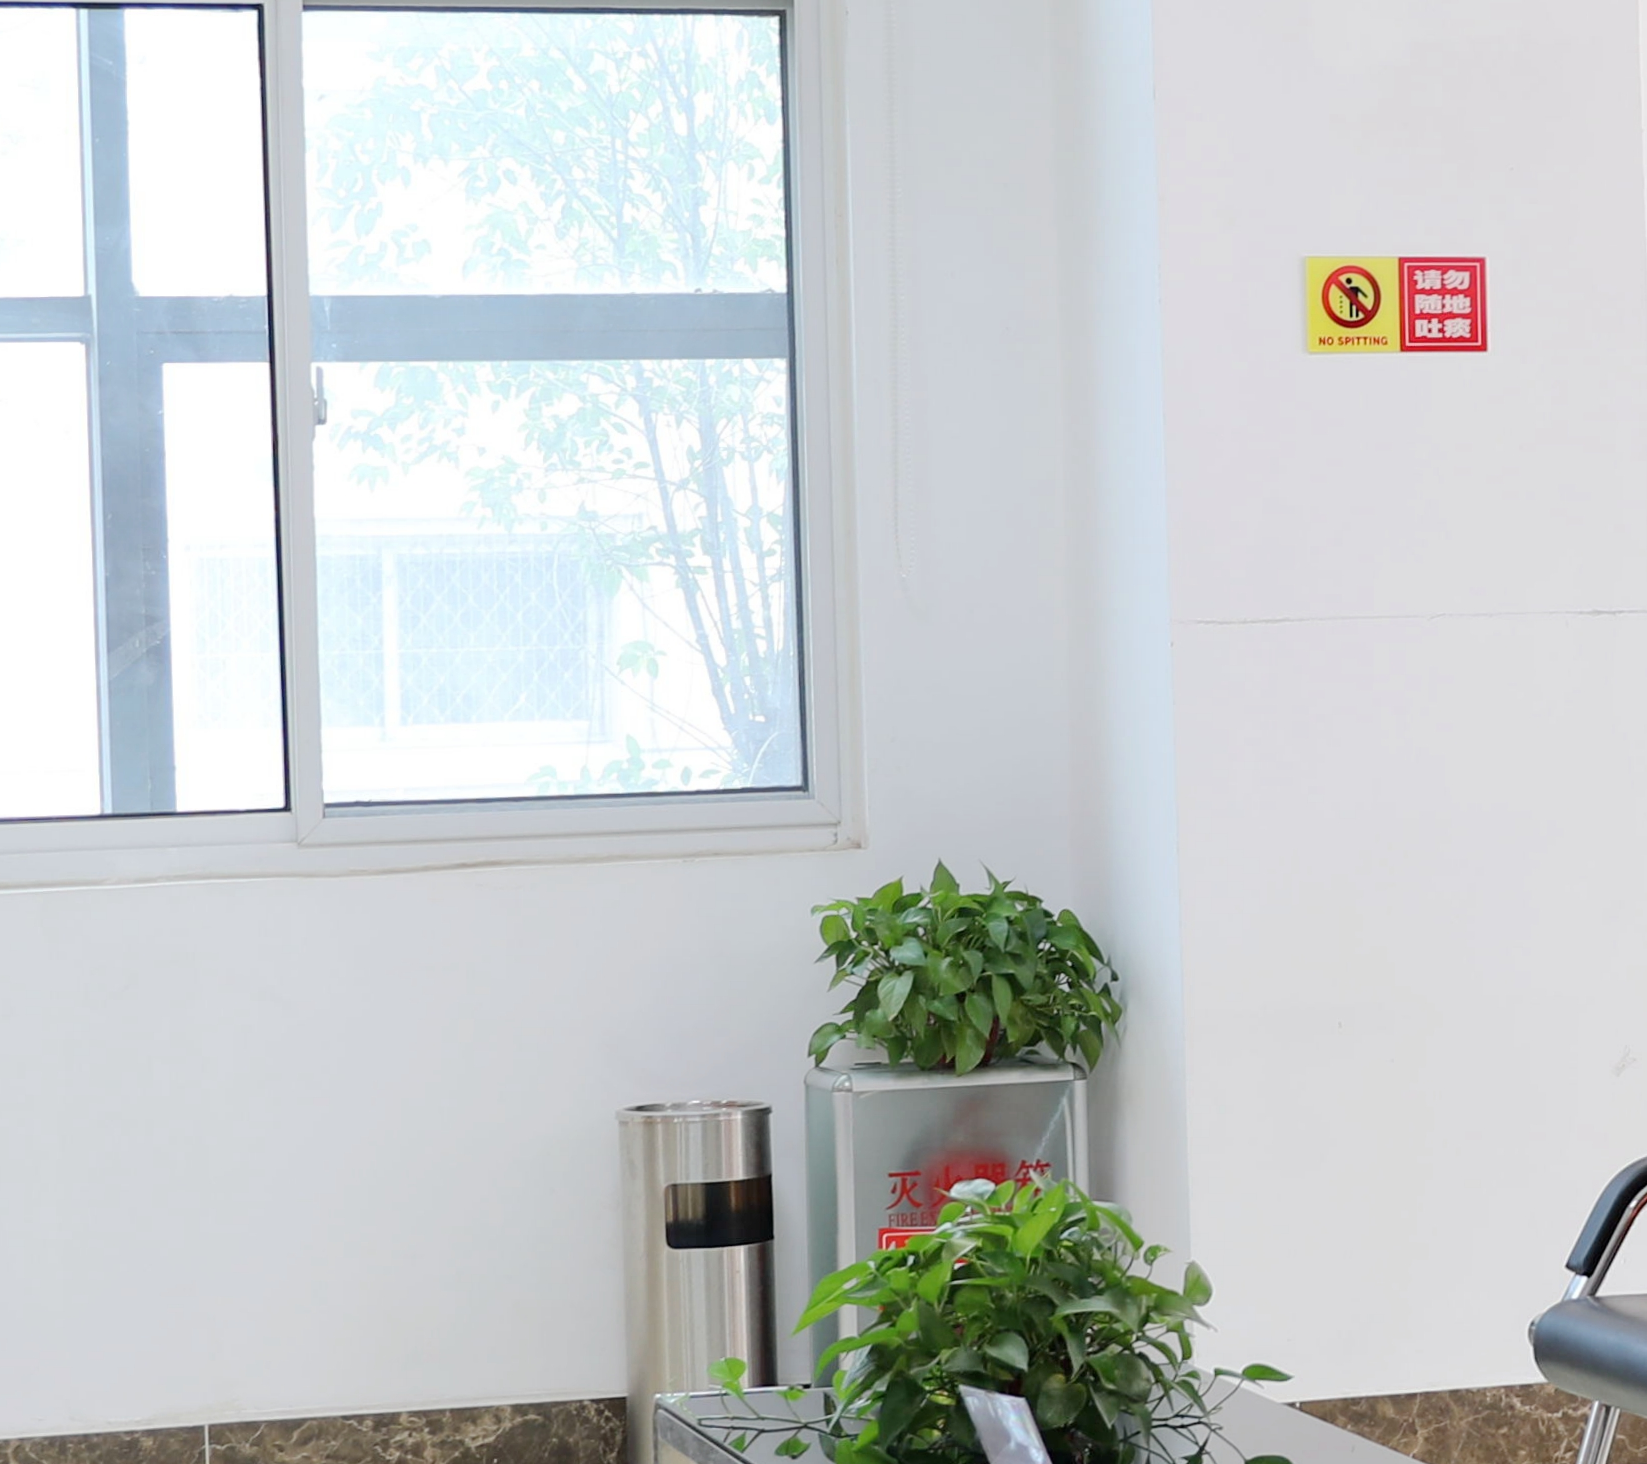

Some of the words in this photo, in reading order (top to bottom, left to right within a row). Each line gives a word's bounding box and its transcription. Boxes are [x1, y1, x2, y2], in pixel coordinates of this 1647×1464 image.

[1413, 269, 1470, 290] 请勿
[1414, 293, 1472, 315] 随地
[1414, 318, 1472, 339] 吐痰
[1318, 336, 1334, 346] NO
[1338, 336, 1388, 346] SPITTING
[888, 1213, 918, 1227] FIRE
